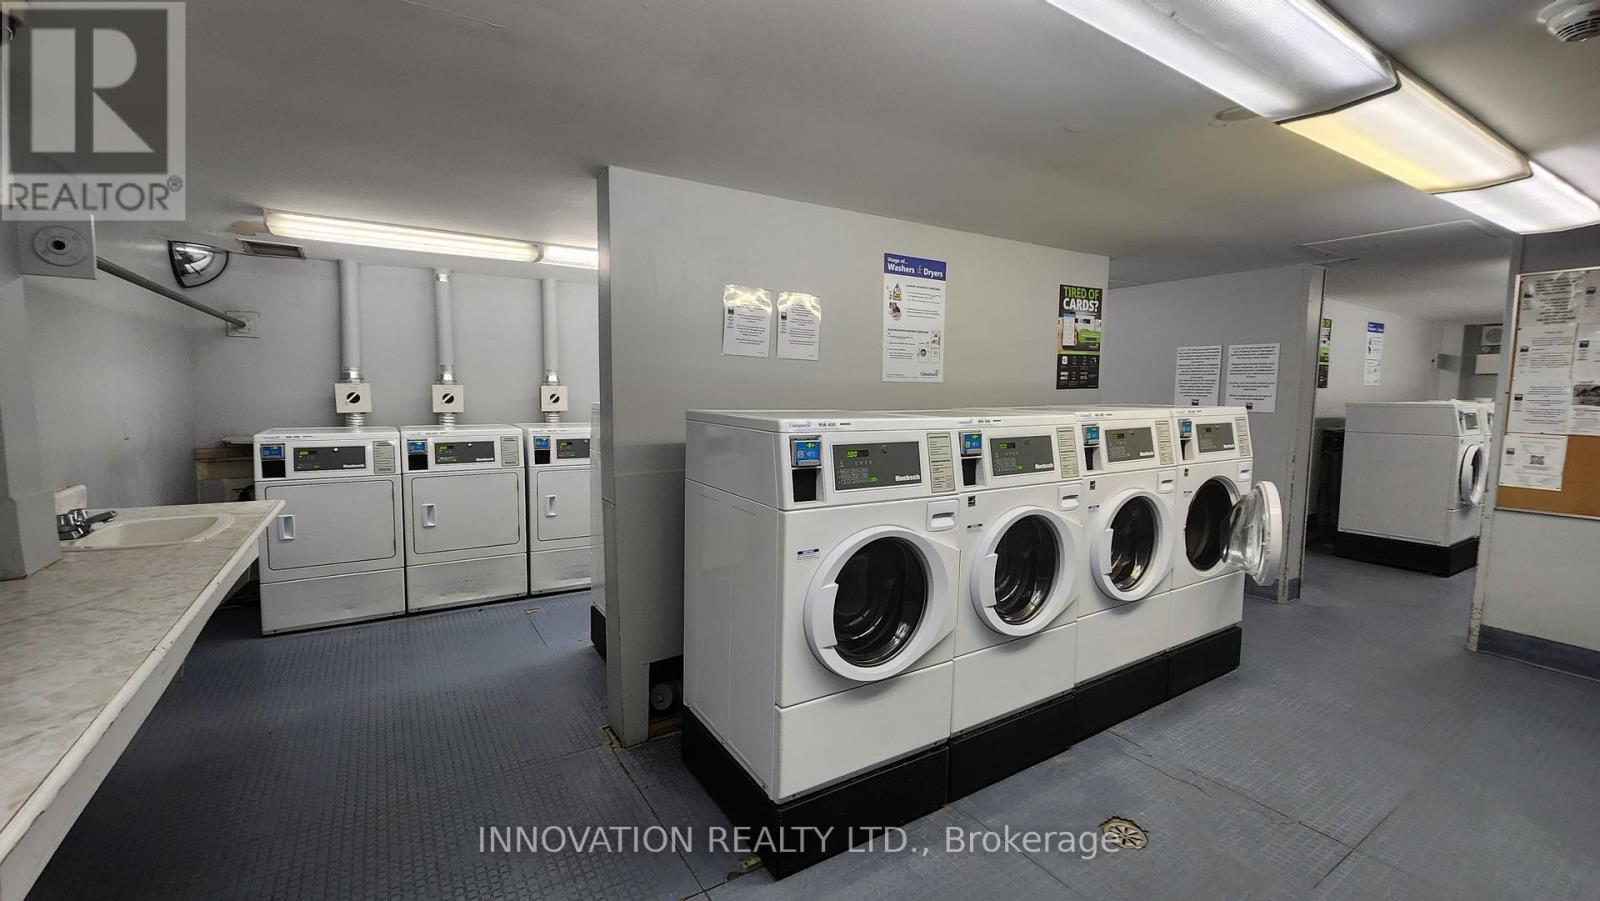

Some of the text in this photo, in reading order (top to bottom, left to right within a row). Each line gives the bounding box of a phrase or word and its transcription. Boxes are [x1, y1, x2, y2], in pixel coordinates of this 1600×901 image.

[887, 263, 915, 274] Washers
[923, 267, 944, 278] Dryers
[1063, 286, 1100, 300] TIRED OF
[1063, 297, 1099, 312] CARDS?
